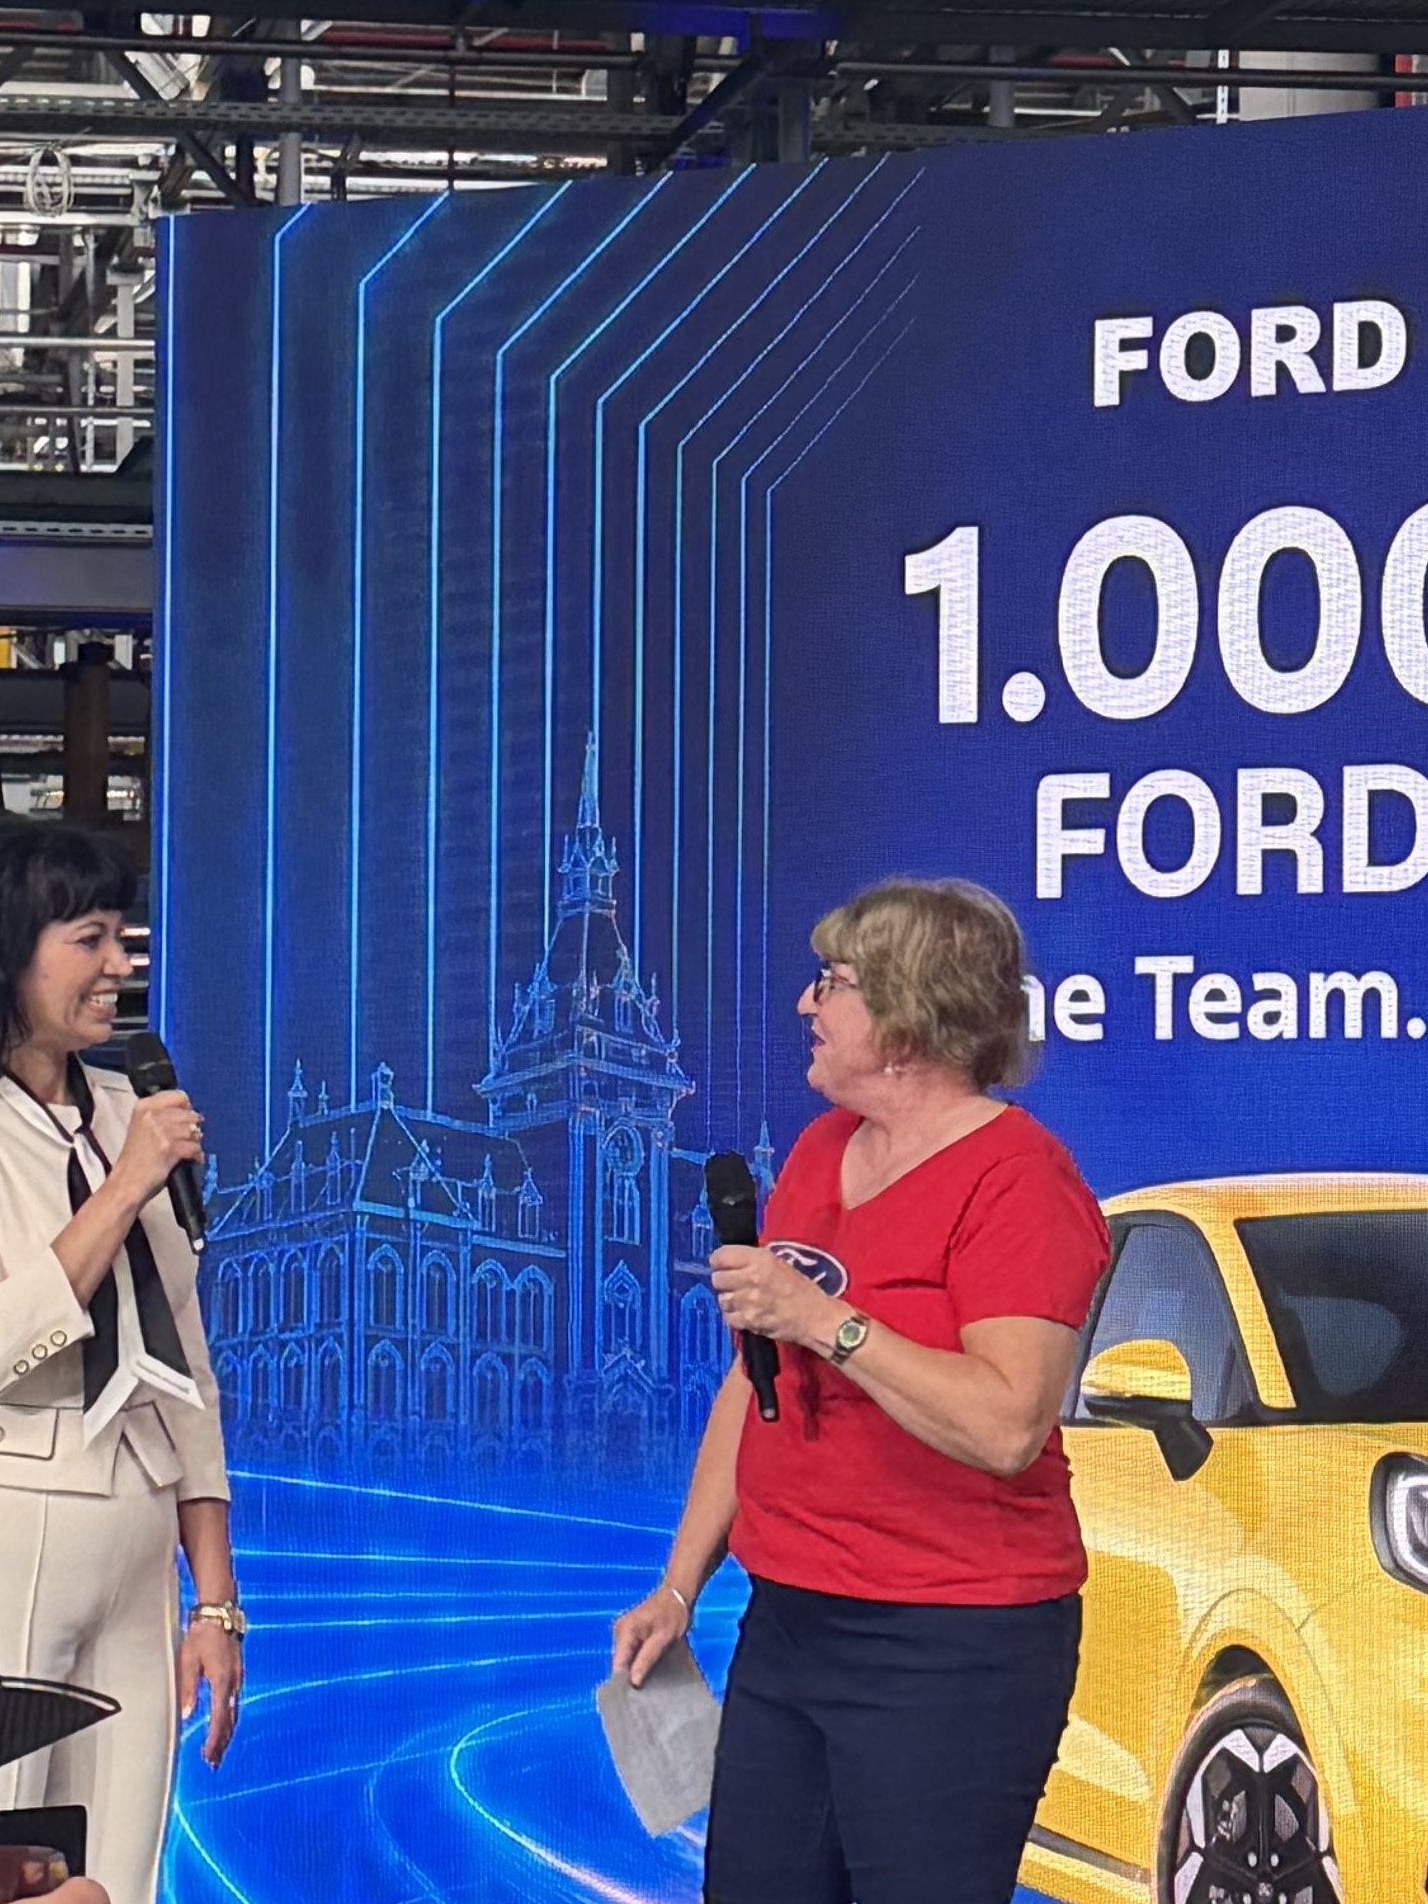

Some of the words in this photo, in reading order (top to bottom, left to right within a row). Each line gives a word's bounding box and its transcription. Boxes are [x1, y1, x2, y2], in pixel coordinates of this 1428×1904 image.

[1093, 300, 1407, 407] FORD
[1019, 974, 1106, 1042] ne
[1134, 955, 1428, 1041] Team.
